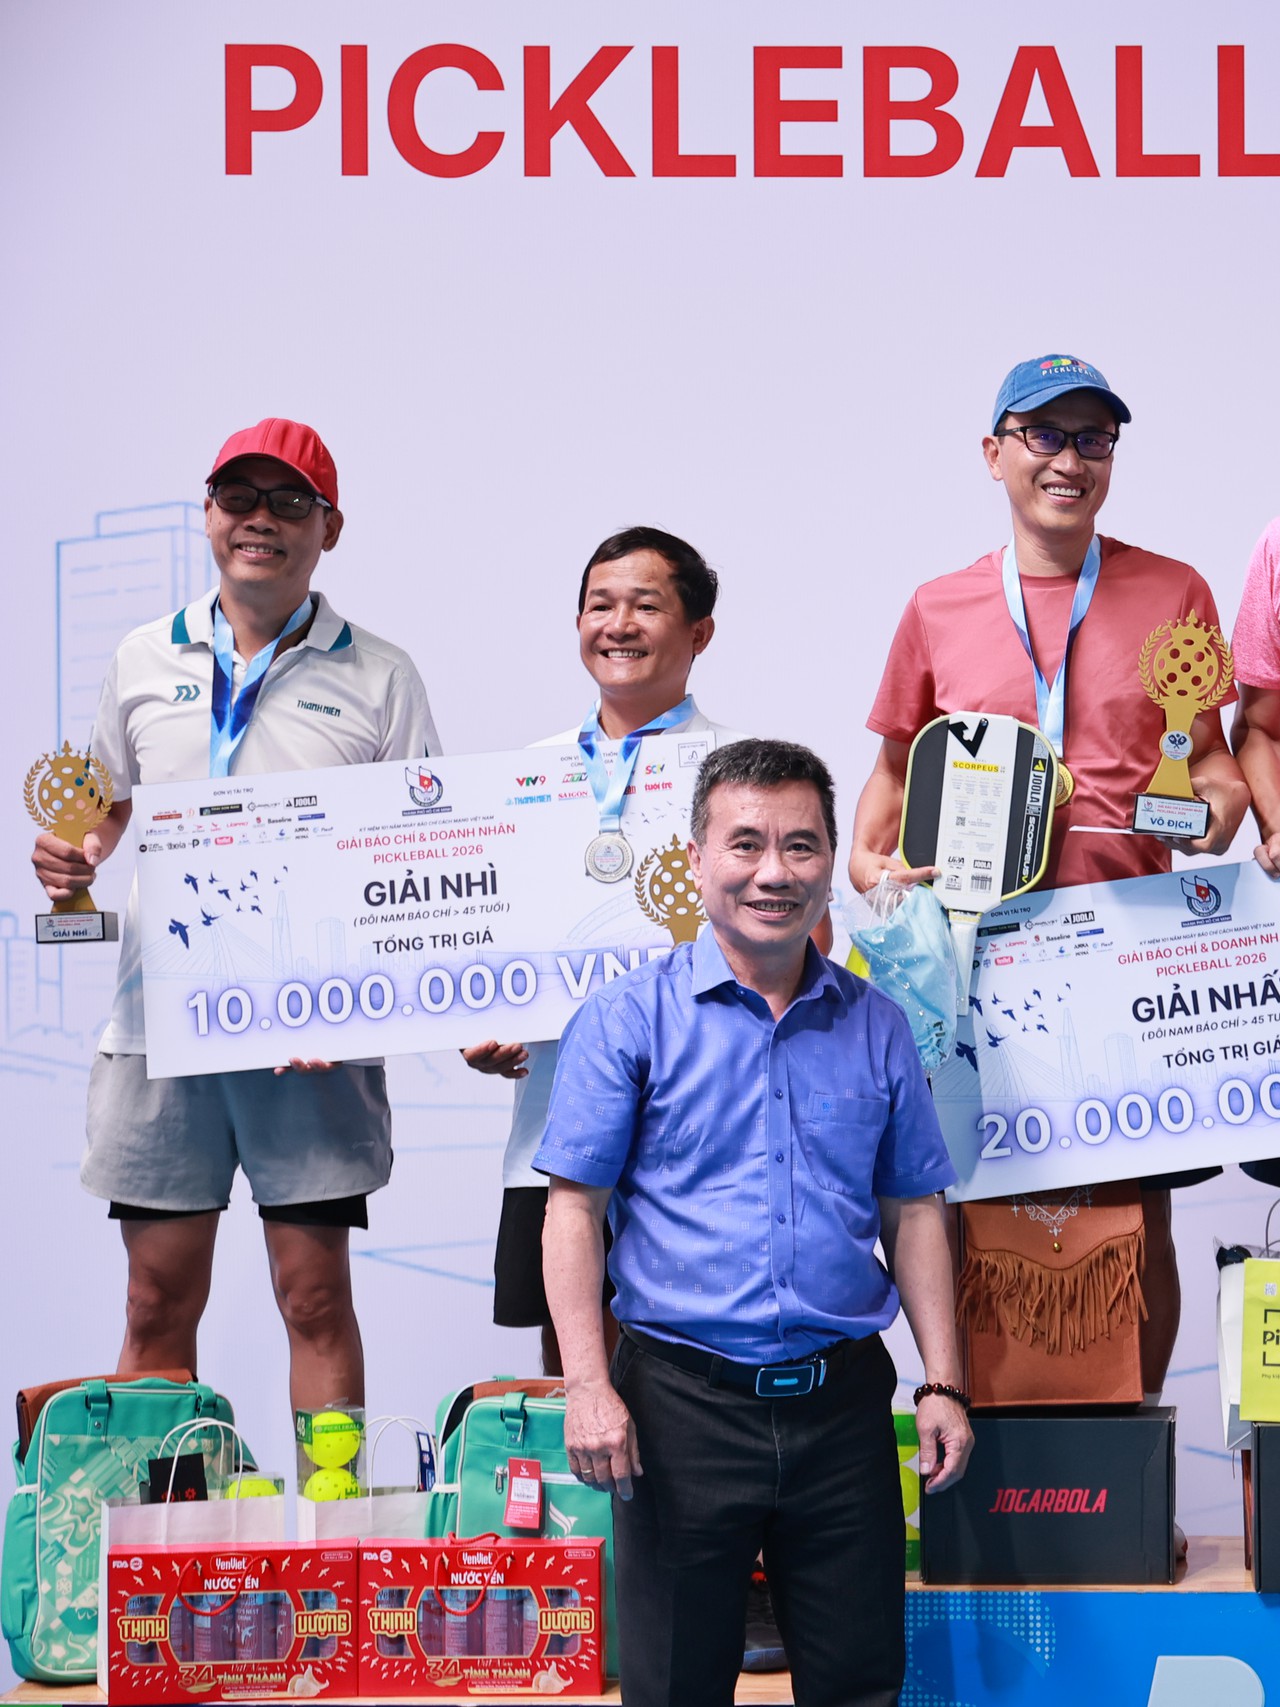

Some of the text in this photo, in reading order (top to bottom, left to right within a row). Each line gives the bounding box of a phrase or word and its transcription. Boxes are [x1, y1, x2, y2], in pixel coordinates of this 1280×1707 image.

[952, 762, 1000, 772] SCORPEUS
[1030, 772, 1043, 803] JOOLA
[294, 796, 317, 807] JOOLA
[268, 816, 292, 825] Baseline
[1150, 816, 1192, 830] VÔ ĐỊCH
[336, 824, 516, 850] GIẢI BÁO CHÍ & DOANH NHÂN
[373, 844, 483, 864] PICKLEBALL 2026
[364, 862, 498, 907] GIẢI NHÌ
[359, 914, 378, 926] ĐÔI
[380, 912, 405, 923] NAM
[408, 908, 430, 921] BÁO
[432, 906, 450, 918] CHÍ
[462, 906, 476, 915] 45
[479, 901, 504, 913] TUỔI
[1072, 912, 1094, 923] JOOLA
[372, 926, 494, 954] TỔNG TRỊ GIÁ
[1046, 934, 1071, 942] Baseline
[1118, 950, 1143, 965] GIẢI
[1146, 947, 1172, 961] BÁO
[1175, 941, 1197, 957] CHÍ
[1200, 943, 1209, 953] &
[1211, 936, 1257, 952] DOANH
[1156, 952, 1267, 977] PICKLEBALL 2026
[187, 946, 672, 1036] 10.000.000 VN
[1132, 983, 1200, 1023] GIẢI
[1148, 1028, 1166, 1039] ĐÔI
[1168, 1025, 1193, 1036] NAM
[1196, 1020, 1218, 1033] BÁO
[1221, 1016, 1240, 1029] CHÍ
[1251, 1015, 1264, 1025] 45
[1162, 1048, 1214, 1068] TỔNG
[1219, 1044, 1249, 1061] TRỊ
[297, 1416, 306, 1437] 48
[989, 1488, 1108, 1513] JOGARBOLA
[112, 1560, 129, 1569] FDA
[216, 1557, 247, 1570] YenViet
[363, 1552, 378, 1561] FDA
[462, 1552, 492, 1565] YenViet
[204, 1577, 235, 1591] NƯỚC
[451, 1572, 481, 1584] NƯỚC
[121, 1619, 166, 1641] THỊNH
[371, 1612, 414, 1633] THỊNH
[179, 1665, 214, 1688] 34
[246, 1672, 287, 1683] THÀNH
[426, 1660, 462, 1680] 34
[492, 1667, 531, 1678] THÀNH
